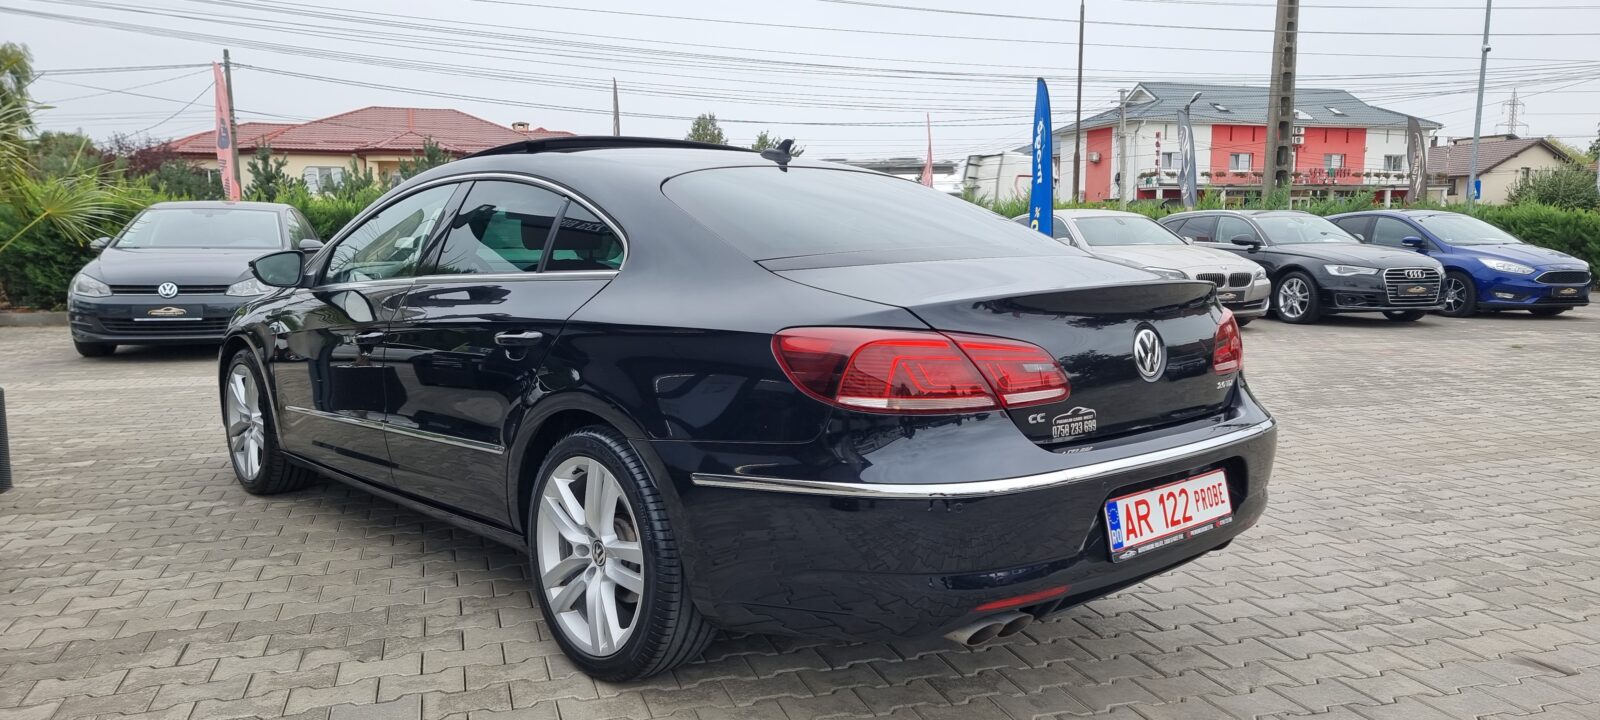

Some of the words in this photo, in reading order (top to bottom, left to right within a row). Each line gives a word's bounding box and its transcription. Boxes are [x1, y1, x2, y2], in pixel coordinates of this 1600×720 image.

[1028, 412, 1046, 424] CC
[1052, 423, 1070, 438] 0758
[1070, 421, 1083, 435] 233
[1084, 419, 1097, 432] 699
[1125, 498, 1154, 541] AR
[1158, 488, 1194, 529] 122
[1193, 483, 1226, 512] PROBE
[1111, 528, 1123, 546] RO
